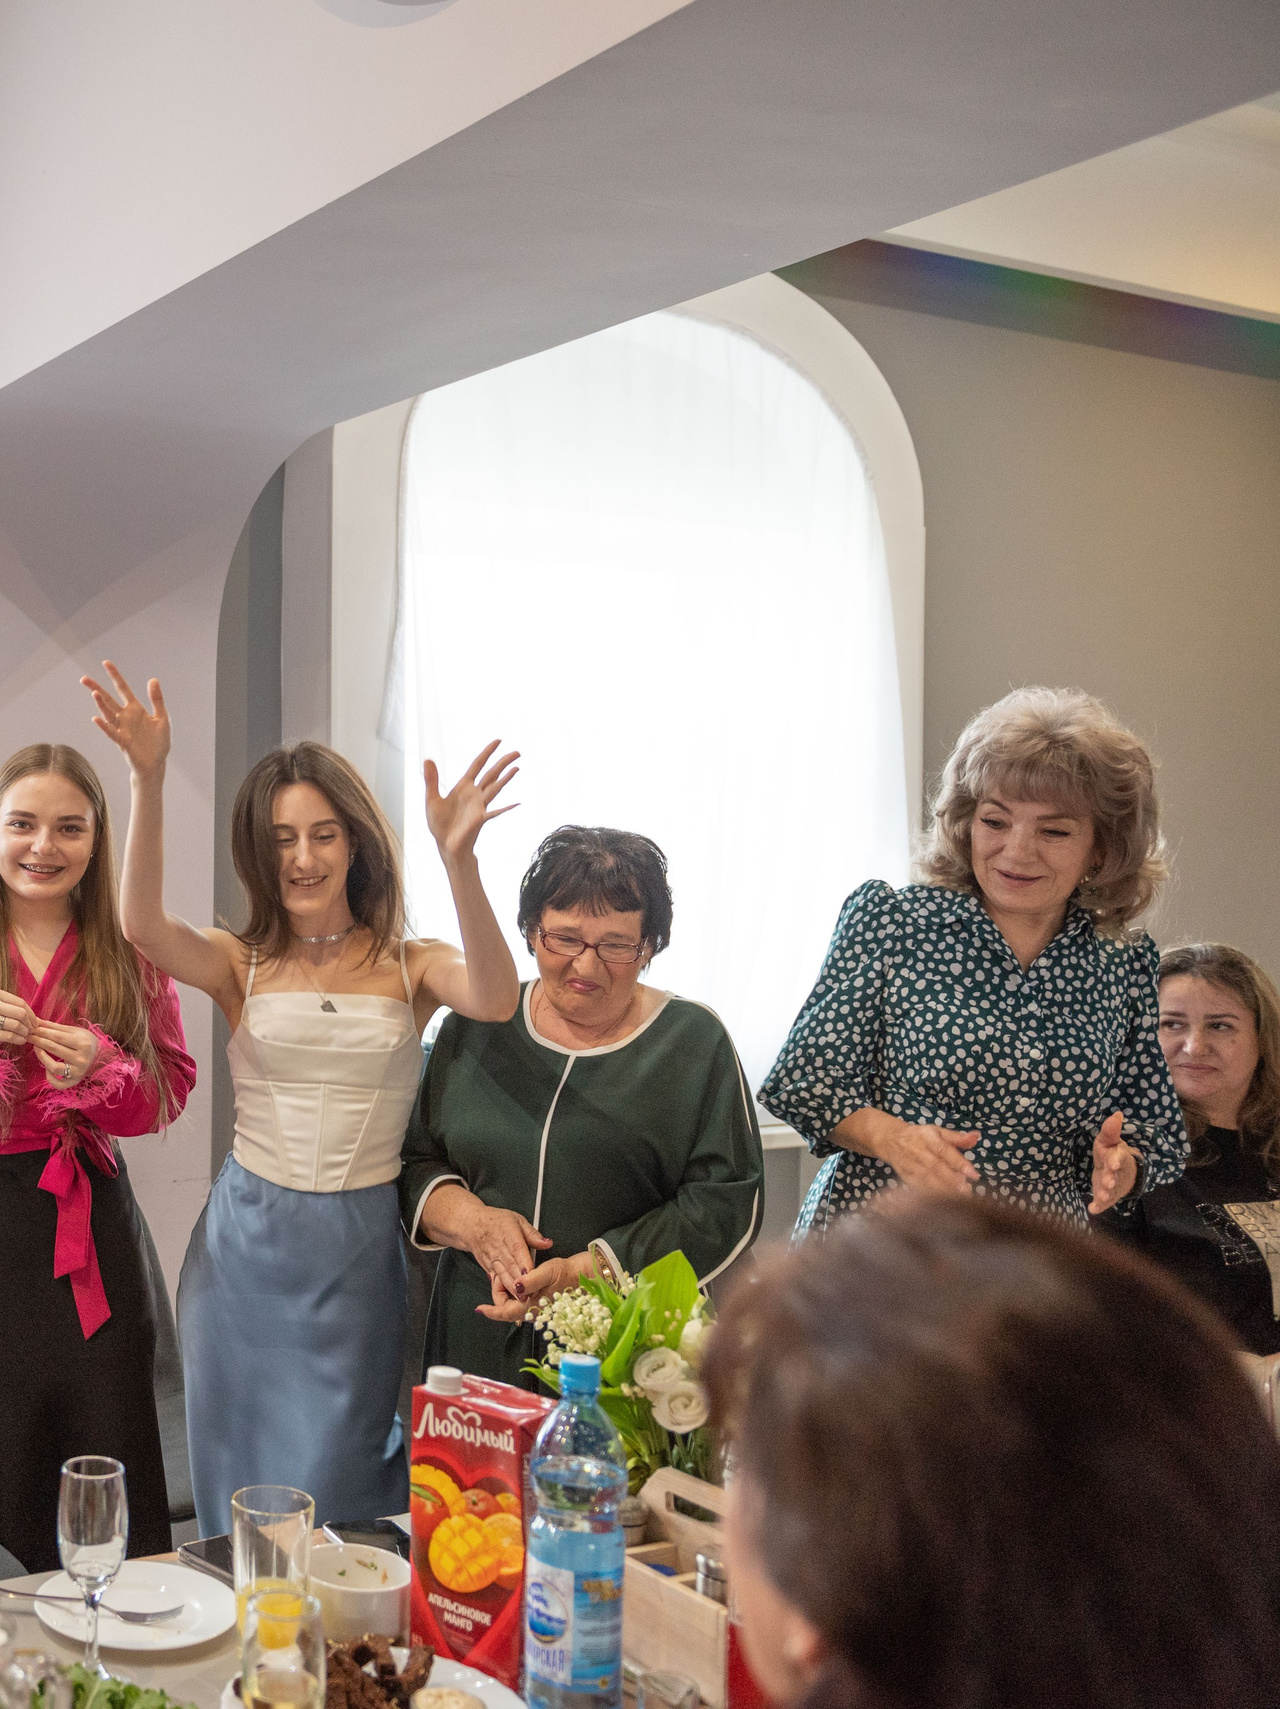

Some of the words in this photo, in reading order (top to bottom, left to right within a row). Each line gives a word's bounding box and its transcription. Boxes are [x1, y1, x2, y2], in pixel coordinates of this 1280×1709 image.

[413, 1402, 516, 1455] Любимый
[428, 1592, 492, 1627] АПЕЛЬСИНОВОЕ
[443, 1611, 473, 1632] МАНГО
